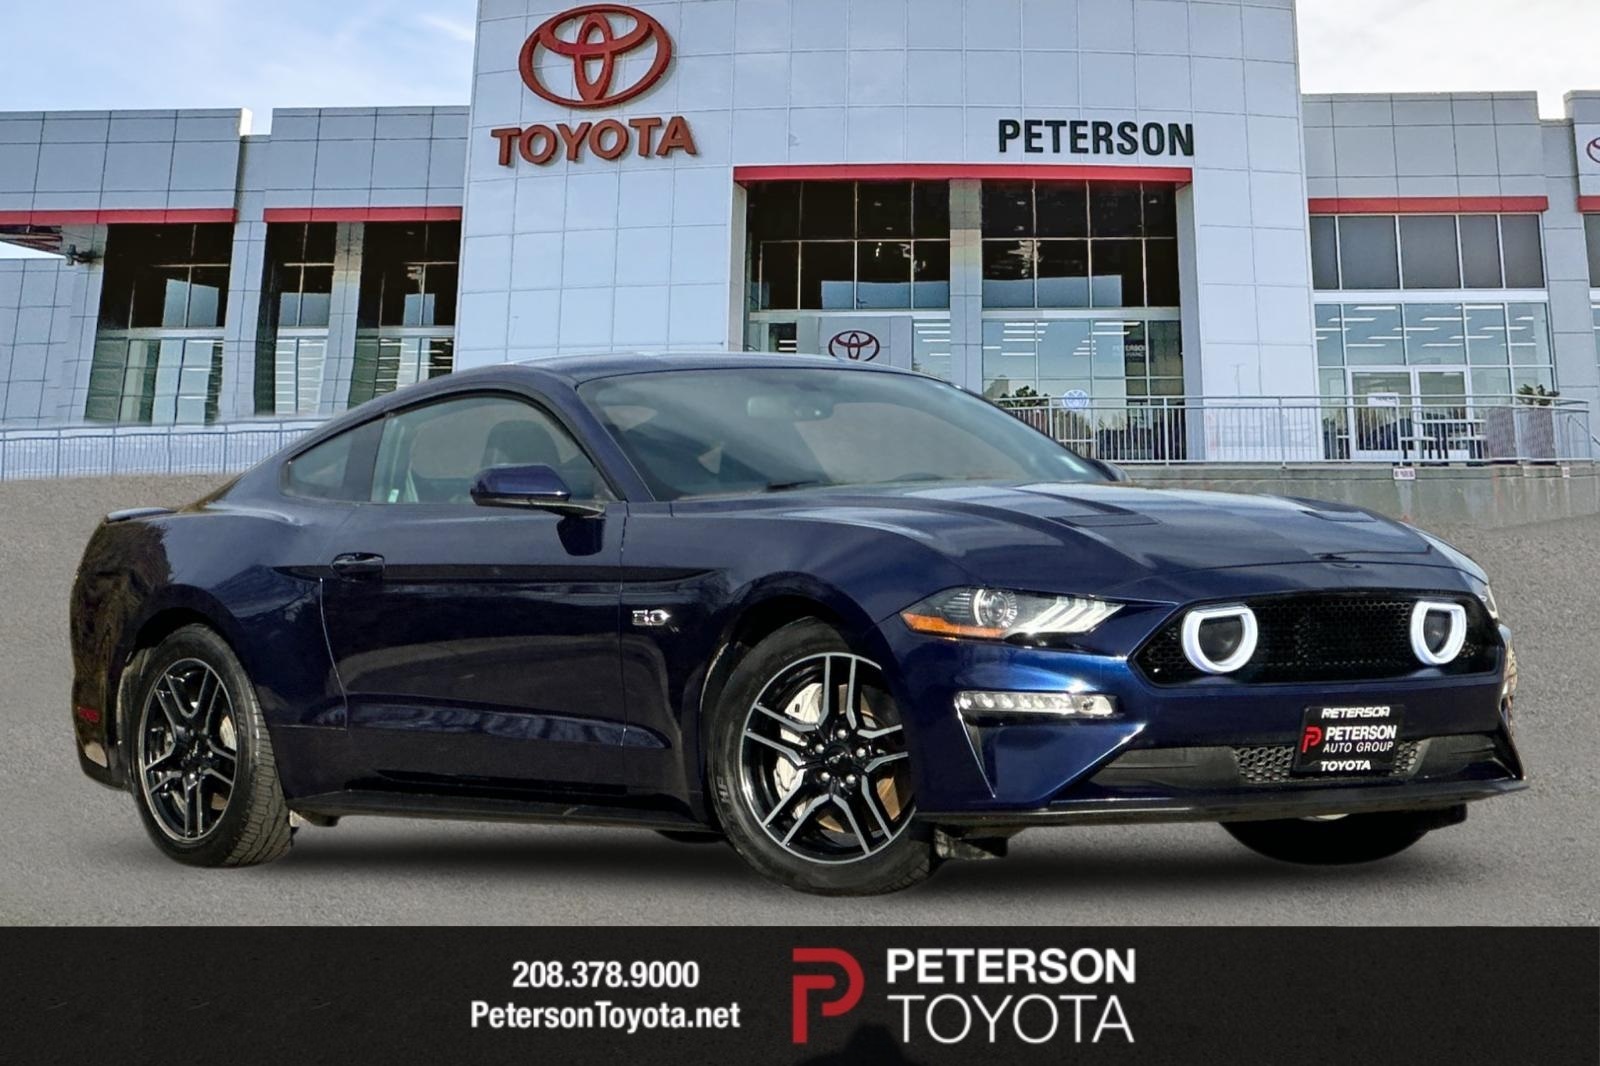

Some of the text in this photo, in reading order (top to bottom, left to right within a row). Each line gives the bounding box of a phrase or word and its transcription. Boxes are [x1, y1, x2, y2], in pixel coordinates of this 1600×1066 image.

[490, 115, 697, 166] TOYOTA
[998, 119, 1194, 156] PETERSON
[1325, 725, 1397, 741] PETERSON
[1322, 741, 1394, 753] AUTO GROUP
[1320, 759, 1372, 772] TOYOTA
